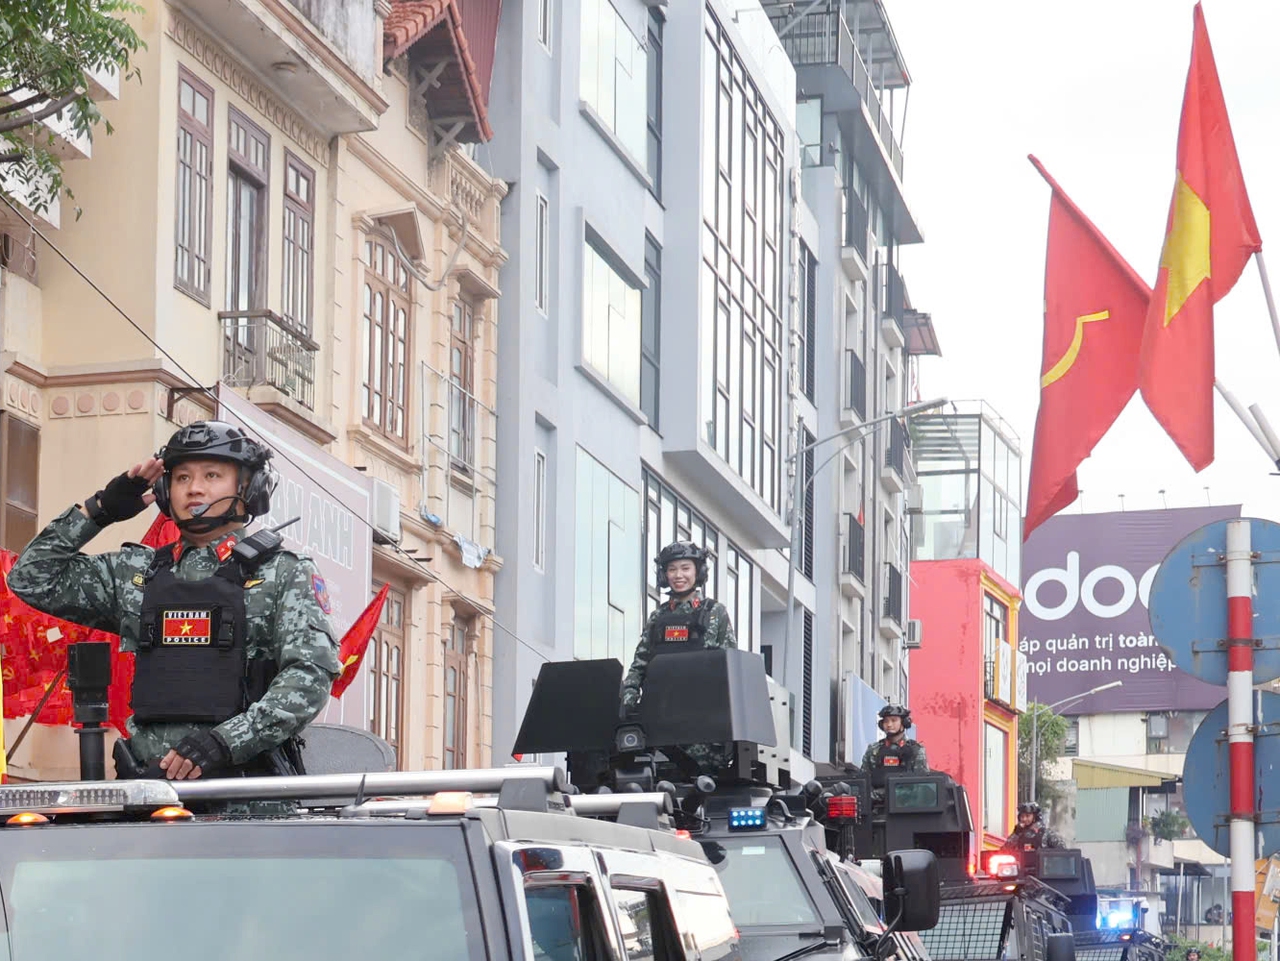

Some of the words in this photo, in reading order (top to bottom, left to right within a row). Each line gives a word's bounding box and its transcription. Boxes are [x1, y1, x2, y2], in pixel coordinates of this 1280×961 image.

[307, 492, 354, 570] ANH
[1024, 551, 1160, 621] do
[1045, 633, 1089, 654] quản
[1094, 633, 1113, 651] trị
[1056, 656, 1112, 672] doanh
